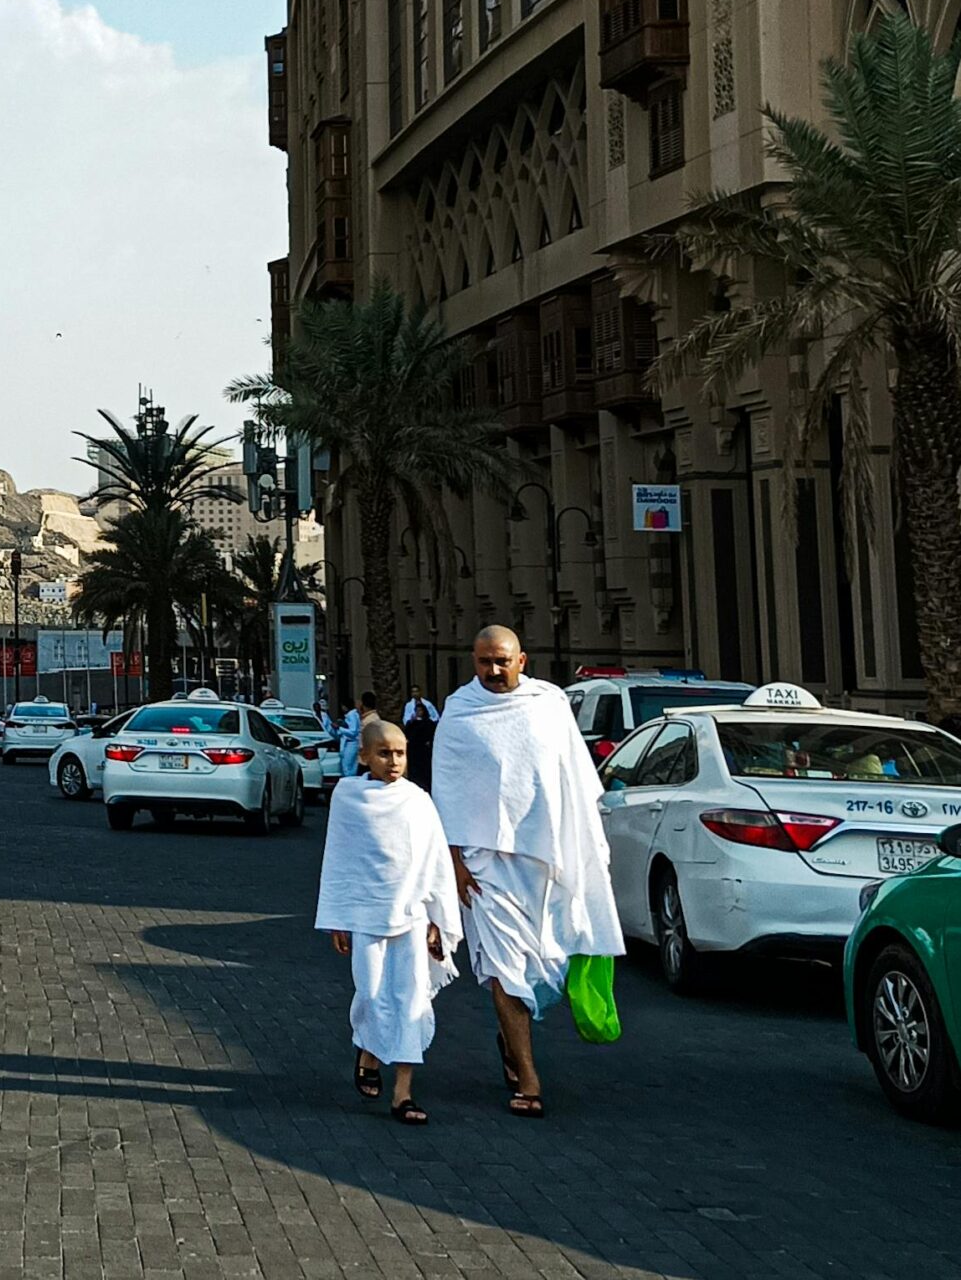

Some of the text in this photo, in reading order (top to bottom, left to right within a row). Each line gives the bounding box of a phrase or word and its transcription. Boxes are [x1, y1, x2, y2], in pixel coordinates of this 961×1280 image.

[766, 688, 798, 699] TAXI
[846, 800, 893, 814] 217-16
[882, 857, 914, 871] 3495
